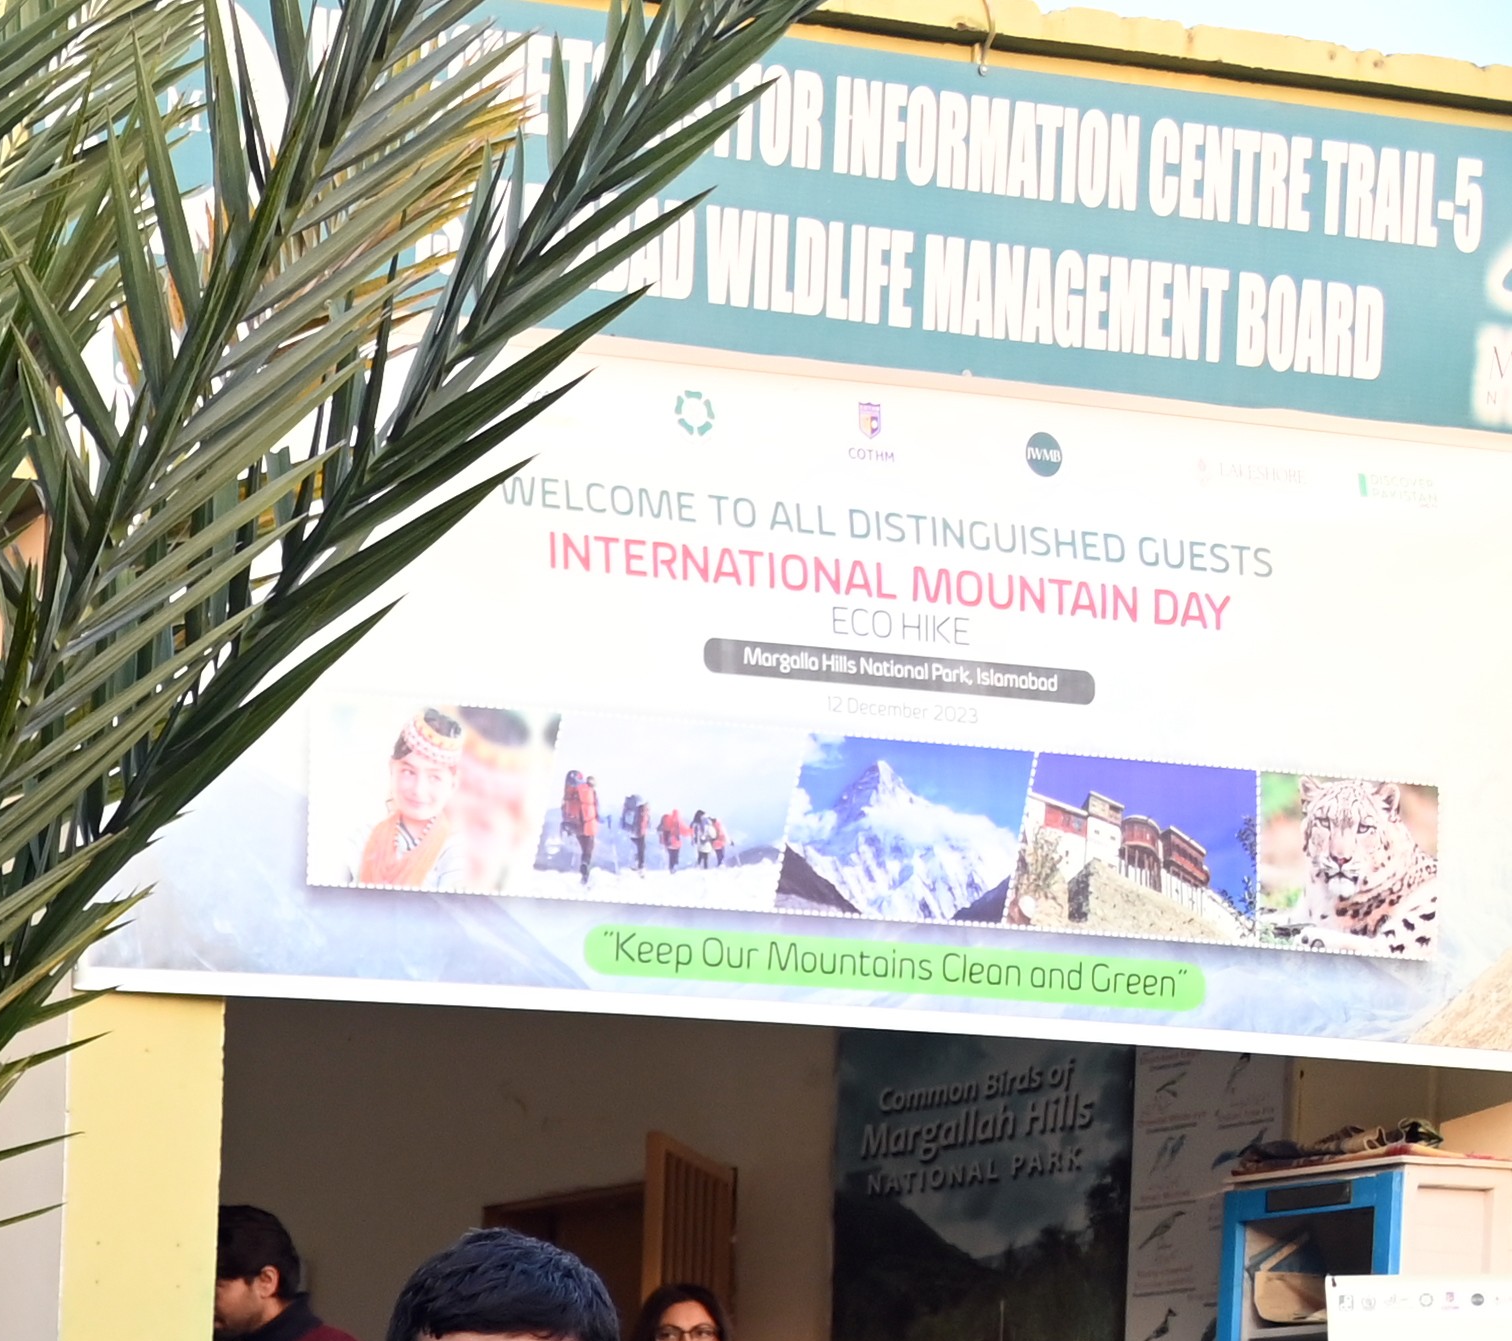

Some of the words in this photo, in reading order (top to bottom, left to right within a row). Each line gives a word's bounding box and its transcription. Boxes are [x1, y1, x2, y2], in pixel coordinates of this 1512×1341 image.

[832, 75, 1141, 212] INFORMATION
[1148, 117, 1314, 233] CENTRE
[1320, 138, 1484, 254] TRAIL-5
[705, 204, 914, 329] WILDLIFE
[921, 233, 1230, 364] MANAGEMENT
[1235, 270, 1385, 381] BOARD
[847, 446, 896, 464] COTHM
[1026, 446, 1063, 464] IWMB
[502, 475, 697, 523] WELCOME
[707, 494, 757, 529] TO
[769, 500, 837, 537] ALL
[848, 508, 1127, 563] DISTINGUISHED
[1137, 535, 1274, 579] GUESTS
[548, 530, 898, 601] INTERNATIONAL
[911, 564, 1139, 624] MOUNTAIN
[1153, 588, 1232, 632] DAY
[831, 605, 893, 639] ECO
[901, 611, 972, 646] HIKE
[742, 645, 820, 675] Margalla
[821, 653, 858, 676] Hills
[859, 656, 929, 682] National
[931, 663, 974, 687] Park,
[976, 666, 1059, 693] Islamabad
[826, 695, 844, 714] 12
[846, 697, 930, 720] December
[933, 704, 980, 725] 2023
[700, 936, 761, 971] Our
[766, 940, 934, 982] Mountains
[941, 951, 1023, 988] Clean
[1028, 960, 1084, 993] and
[879, 1080, 978, 1114] Common
[984, 1066, 1043, 1099] Birds
[1049, 1058, 1076, 1091] of
[861, 1104, 1015, 1163] Margallah
[1026, 1093, 1095, 1136] Hills
[867, 1159, 999, 1196] NATIONAL
[1012, 1147, 1083, 1179] PARK
